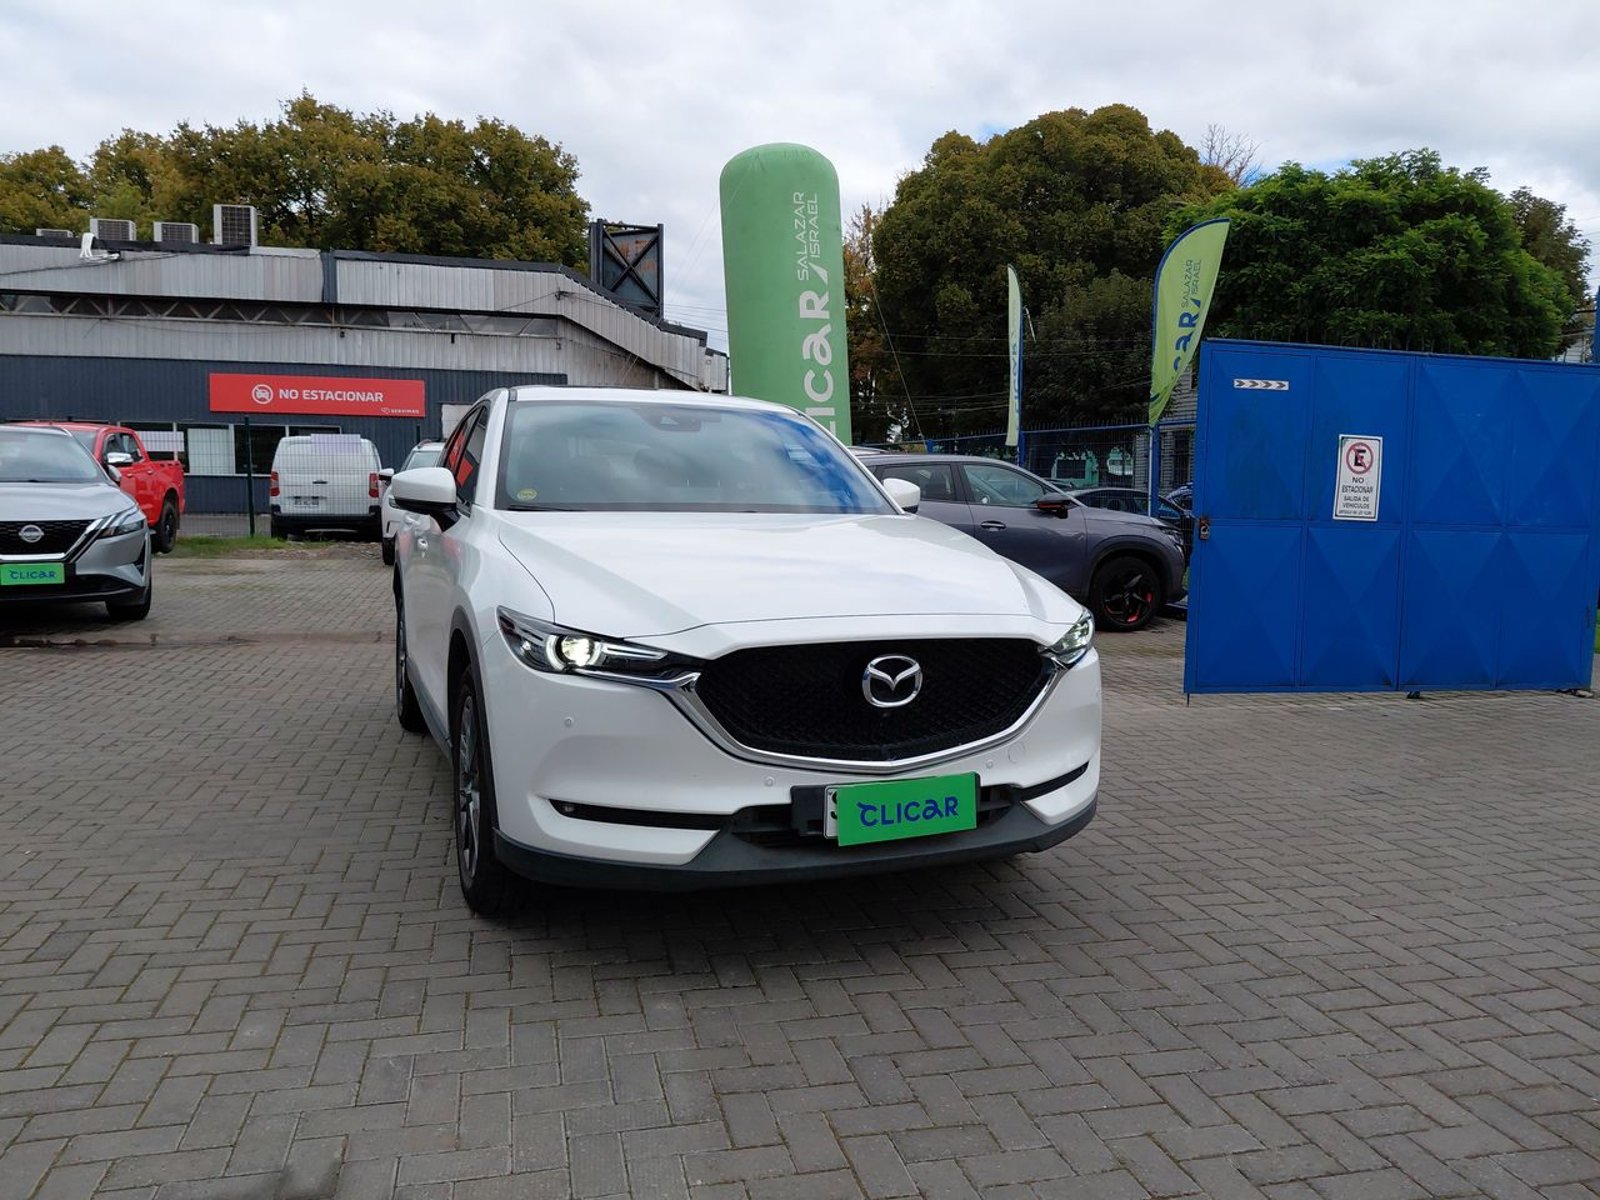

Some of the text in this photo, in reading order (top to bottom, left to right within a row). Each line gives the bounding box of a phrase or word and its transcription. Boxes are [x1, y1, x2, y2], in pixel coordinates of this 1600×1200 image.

[793, 191, 810, 281] SALAZAR
[807, 193, 821, 259] ISRAEL
[1181, 259, 1193, 308] SALAZAR
[279, 389, 384, 402] NO ESTACIONAR
[1342, 485, 1373, 493] ESTACIONAR
